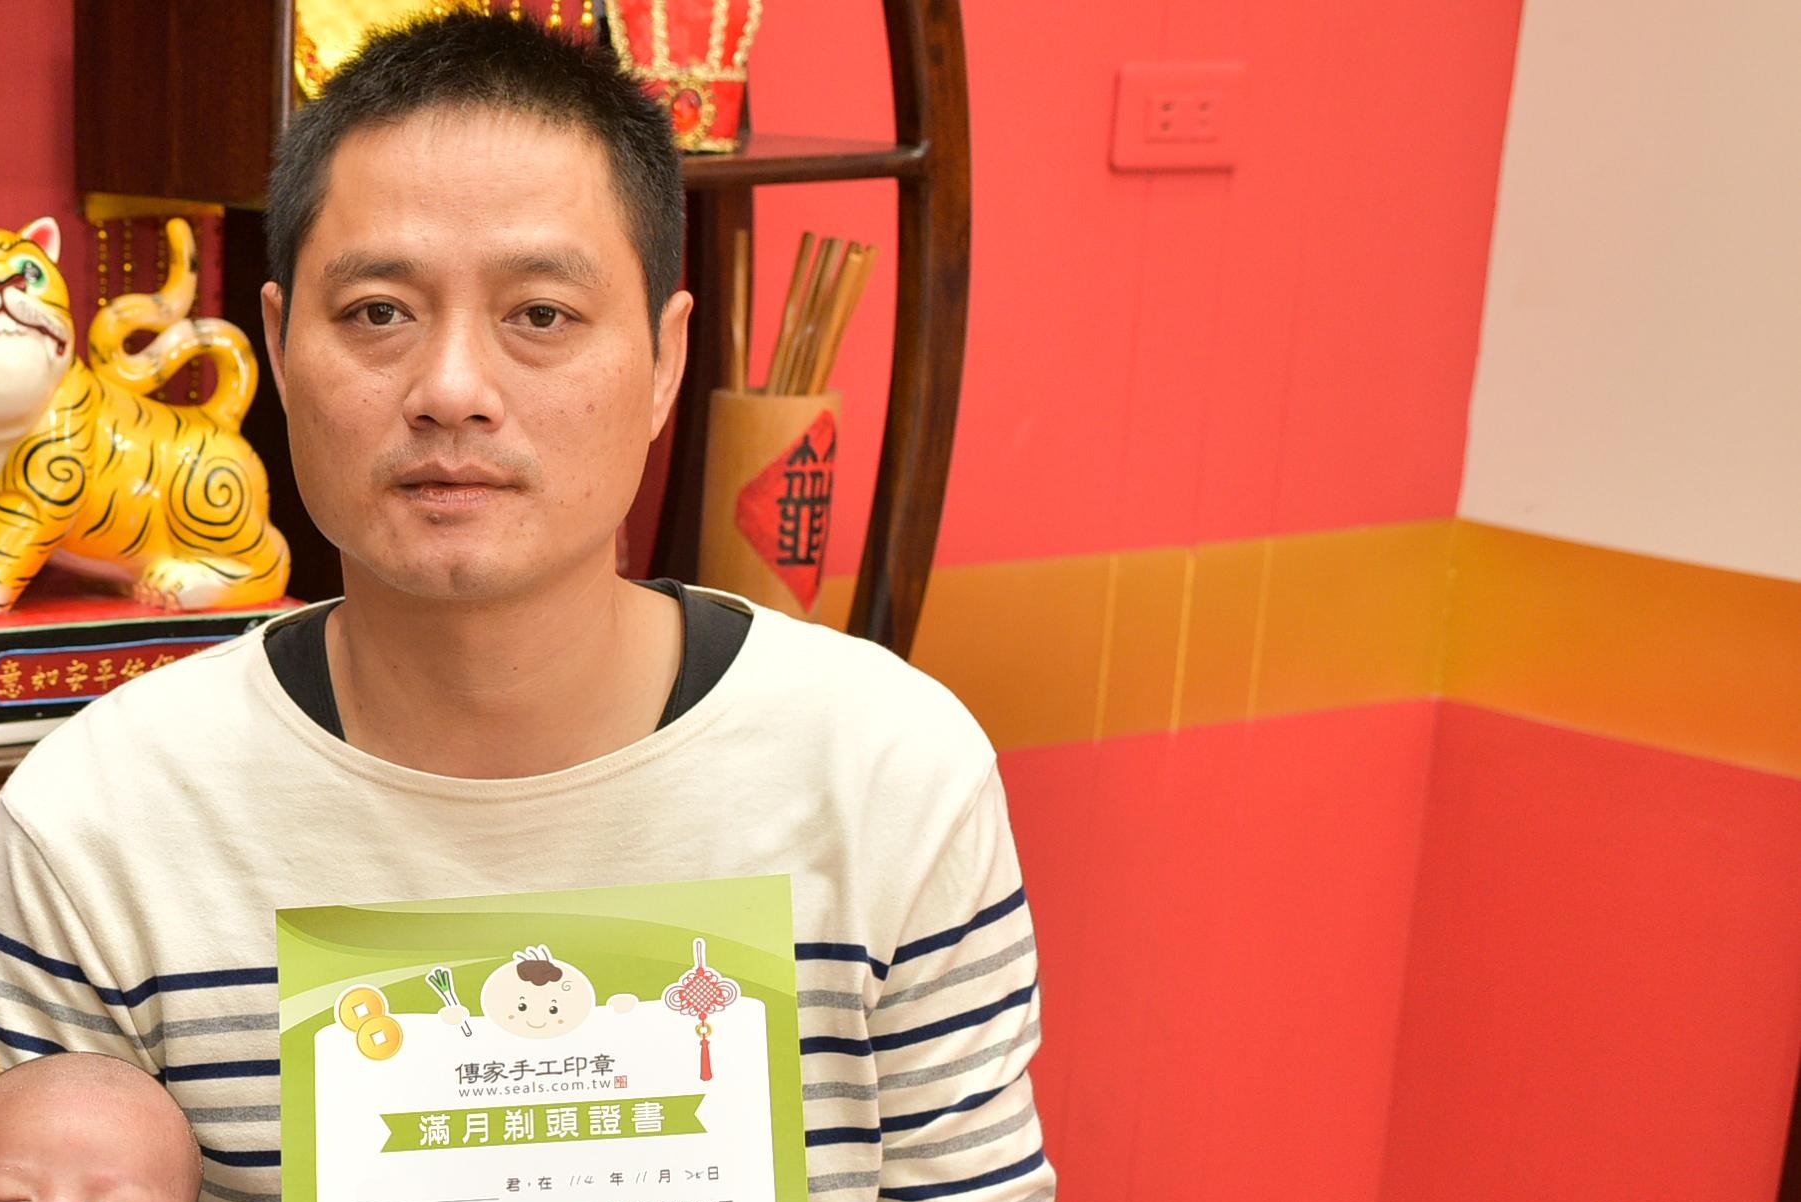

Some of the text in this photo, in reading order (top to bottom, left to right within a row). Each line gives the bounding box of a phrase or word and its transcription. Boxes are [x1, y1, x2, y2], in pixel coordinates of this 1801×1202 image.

[455, 1053, 615, 1085] 傳家手工印章
[458, 1078, 612, 1098] www.seals.com.tw
[418, 1101, 665, 1147] 滿月剃頭證書
